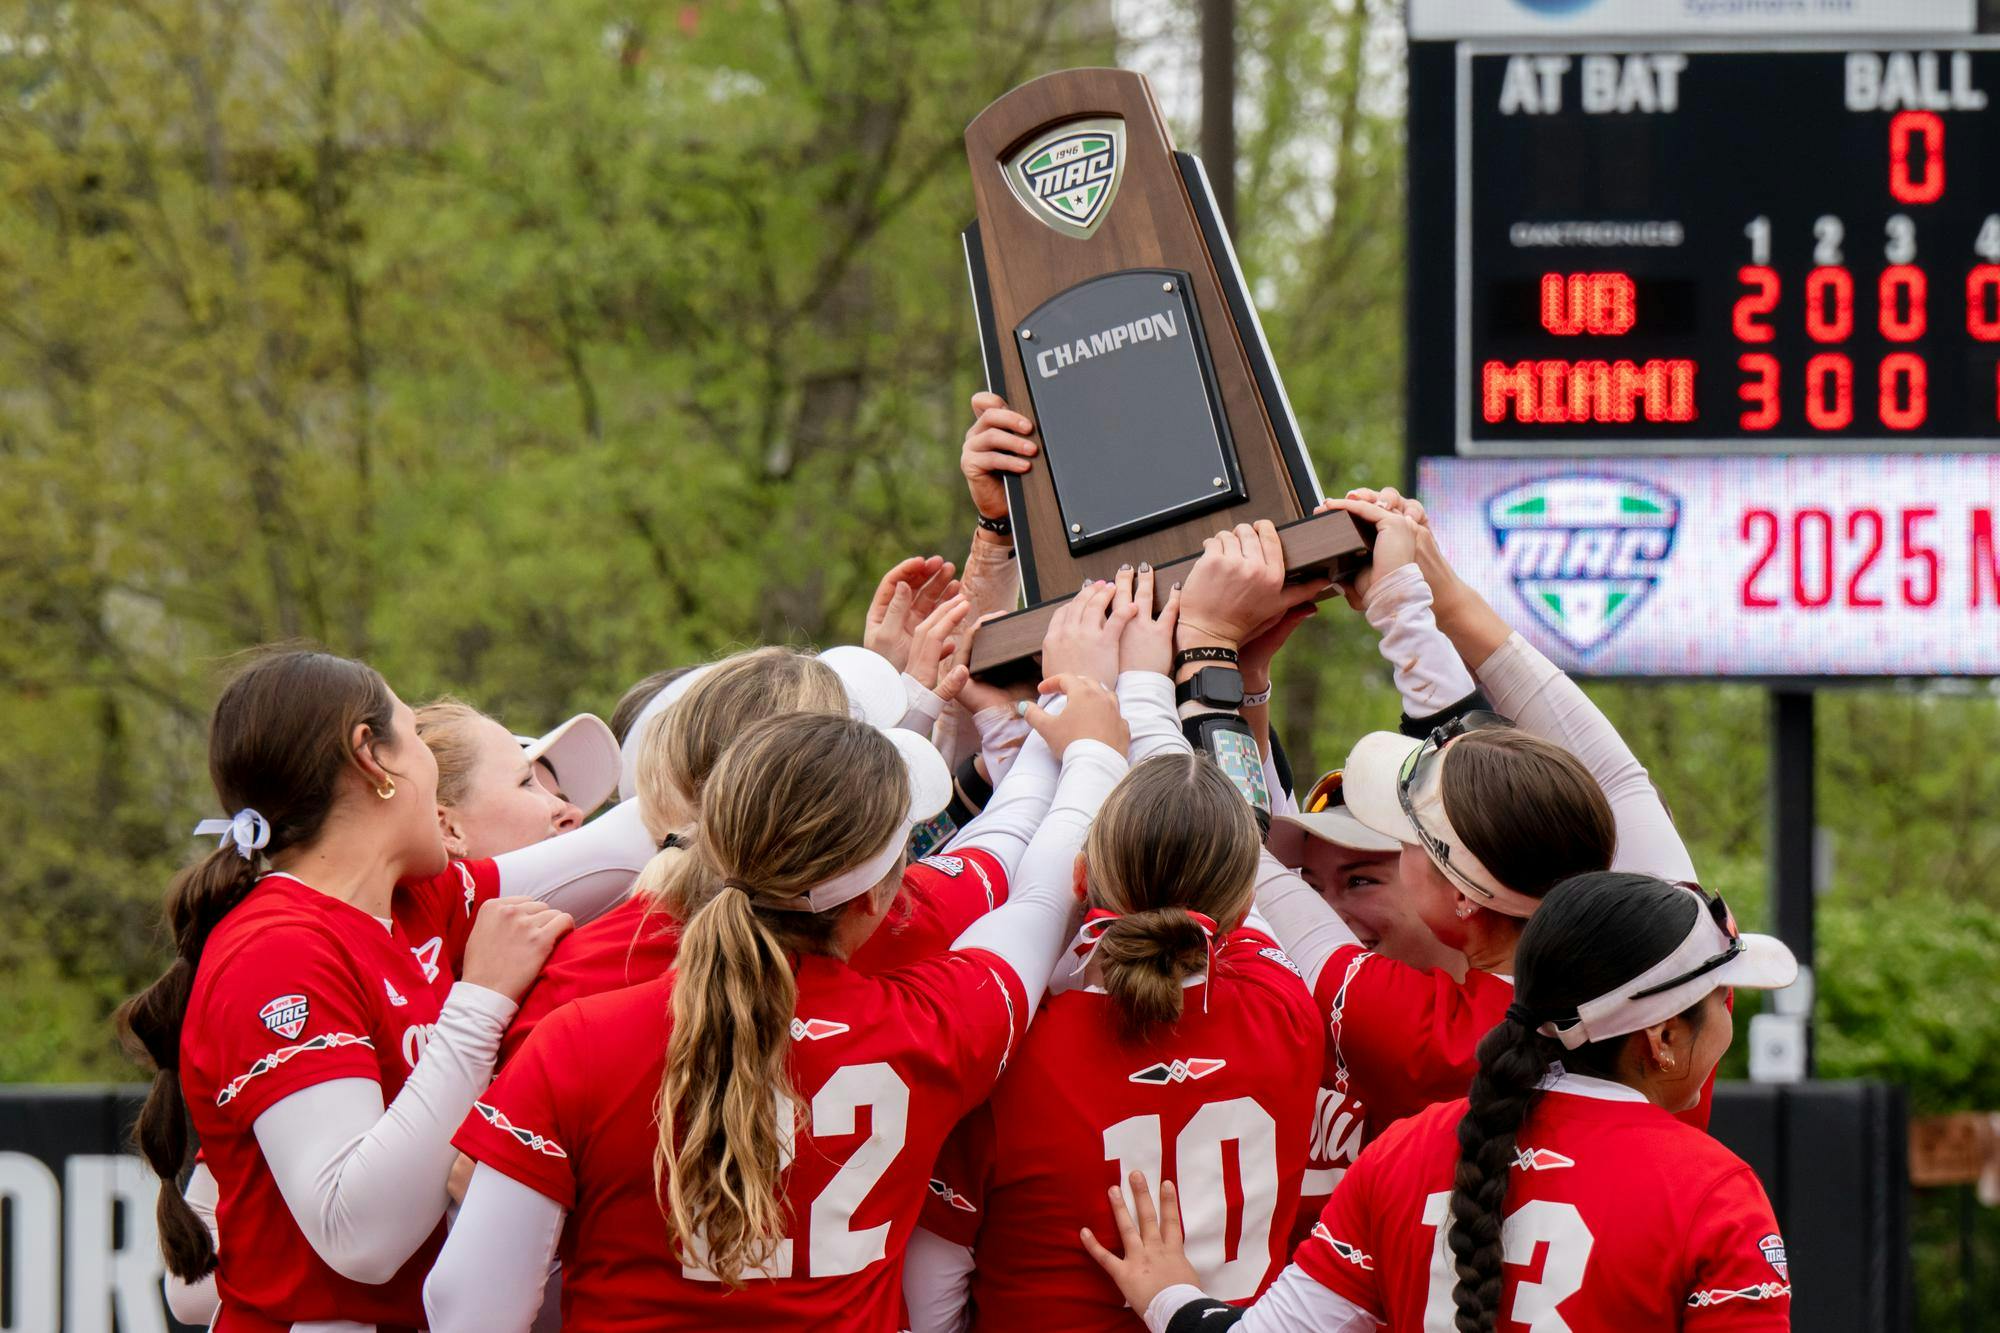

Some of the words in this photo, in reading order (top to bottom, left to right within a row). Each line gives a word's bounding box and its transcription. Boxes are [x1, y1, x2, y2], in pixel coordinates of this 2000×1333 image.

[1499, 54, 1571, 115] AT
[1581, 54, 1687, 114] BAT
[1844, 51, 1988, 111] BALL
[1034, 152, 1113, 198] MAC
[1056, 146, 1079, 160] 1946
[1888, 109, 1946, 204] 0
[1745, 216, 1771, 265] 1
[1813, 215, 1844, 265] 2
[1884, 214, 1917, 264] 3
[1541, 272, 1636, 336] UB
[1733, 265, 1781, 343] 2
[1806, 265, 1854, 343] 0
[1878, 264, 1927, 342] 0
[1036, 309, 1178, 378] CHAMPION
[1482, 359, 1697, 423] MIAMI
[1737, 353, 1781, 430] 3
[1806, 353, 1854, 430] 0
[1878, 352, 1927, 430] 0
[1738, 507, 1939, 609] 2025
[264, 1004, 309, 1030] MAC
